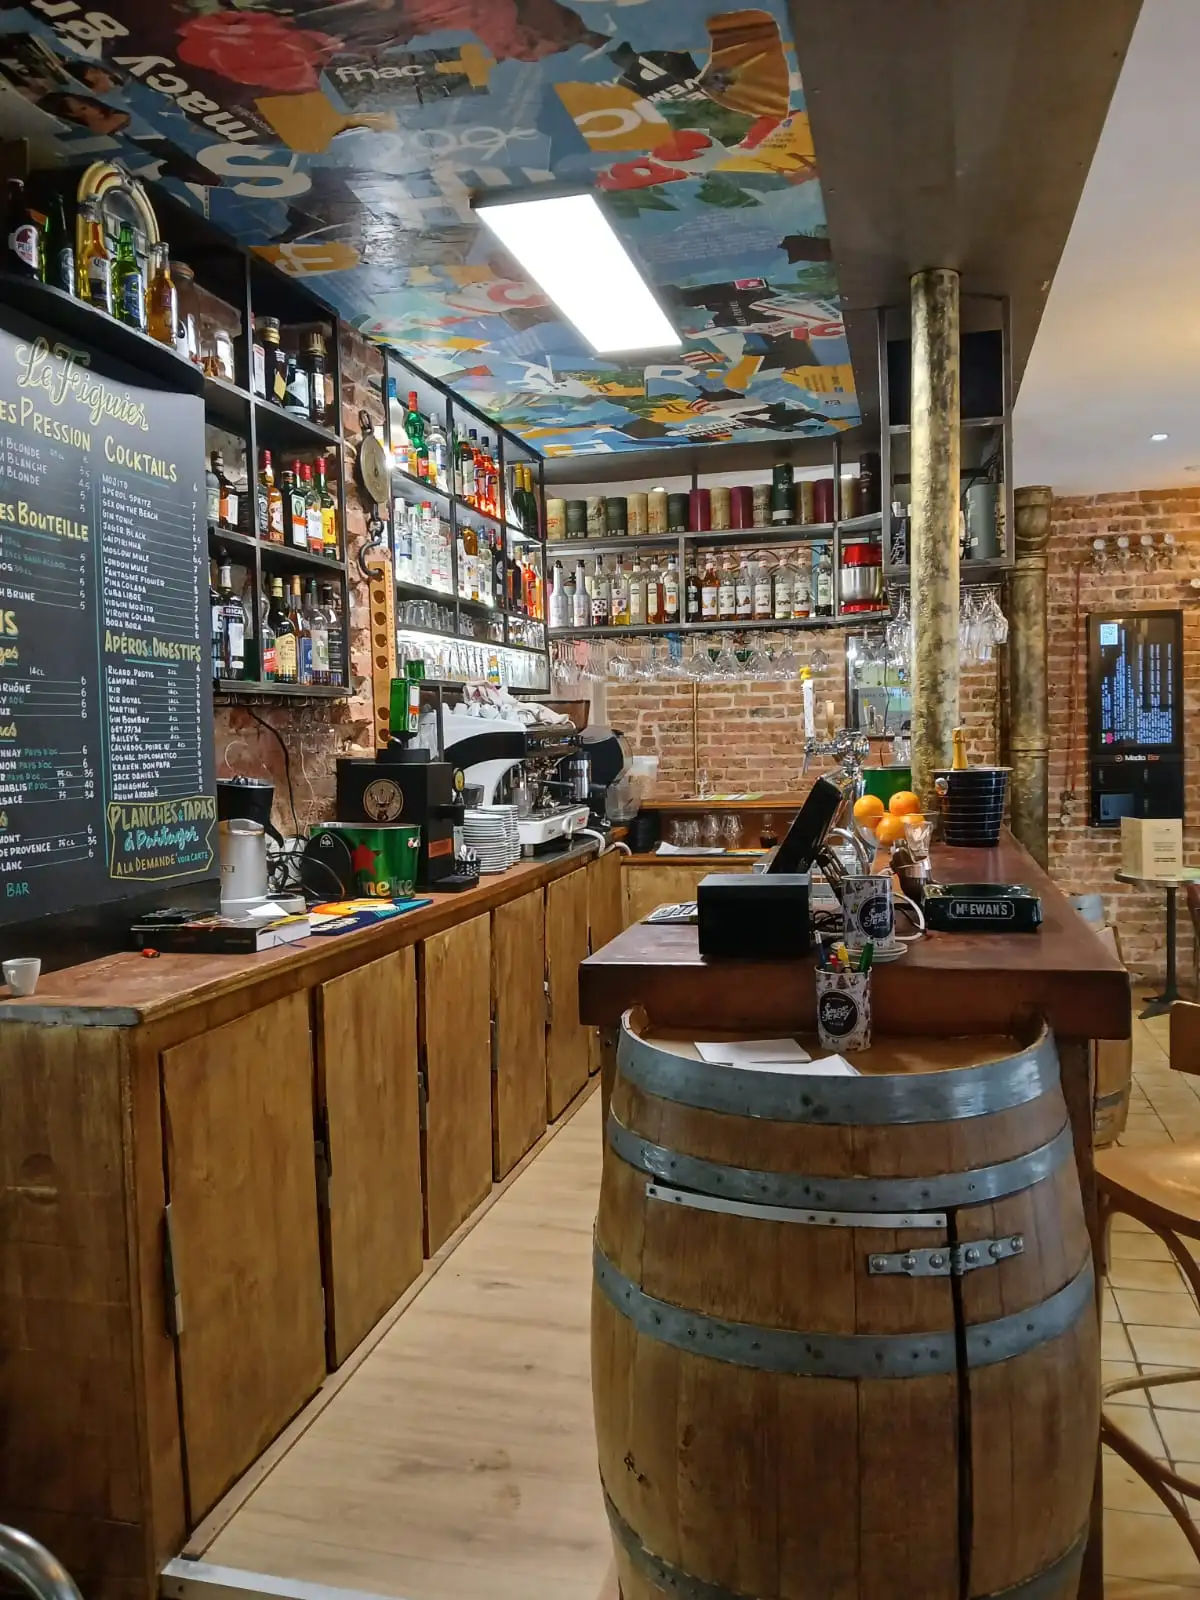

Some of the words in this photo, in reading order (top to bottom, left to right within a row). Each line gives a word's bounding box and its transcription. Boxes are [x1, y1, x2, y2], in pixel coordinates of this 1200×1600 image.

[335, 64, 427, 84] fnac
[112, 55, 259, 141] macy
[15, 337, 52, 388] Le
[20, 396, 91, 451] PRESSION
[7, 437, 40, 460] BLONDE
[8, 452, 48, 474] BLANCHE
[104, 435, 177, 483] COCKTAILS
[6, 466, 40, 486] BLONDE
[103, 474, 128, 490] MOJITO
[103, 498, 115, 508] SEX
[116, 502, 125, 512] ON
[139, 508, 158, 520] BEACH
[18, 501, 89, 542] BOUTEILLE
[104, 556, 130, 569] LONDON
[104, 566, 138, 582] FANTASME
[7, 588, 35, 601] BRUNE
[104, 587, 122, 598] CUBA
[123, 592, 142, 602] LIBRE
[122, 582, 146, 593] COLADA
[106, 618, 123, 628] BORA
[125, 621, 142, 631] BORA
[131, 612, 155, 623] COLADA
[105, 630, 148, 657] APÉROS
[152, 637, 201, 663] DIGESTIFS
[3, 682, 31, 693] RHÔNE
[108, 677, 137, 686] CAMPARI
[109, 686, 120, 694] KIR
[109, 705, 137, 714] MARTINI
[110, 715, 120, 723] GIN
[122, 715, 150, 724] BOMBAY
[111, 734, 139, 742] BAILEY'S
[138, 752, 177, 760] DIPLOMATICO
[132, 771, 159, 780] DANIEL'S
[114, 782, 149, 791] ARMAGNAC
[110, 802, 178, 831] PLANCHES
[181, 799, 214, 821] TAPAS
[10, 842, 51, 856] PROVENCE
[124, 862, 134, 874] LA
[191, 851, 208, 861] CARTE
[7, 882, 30, 897] BAR
